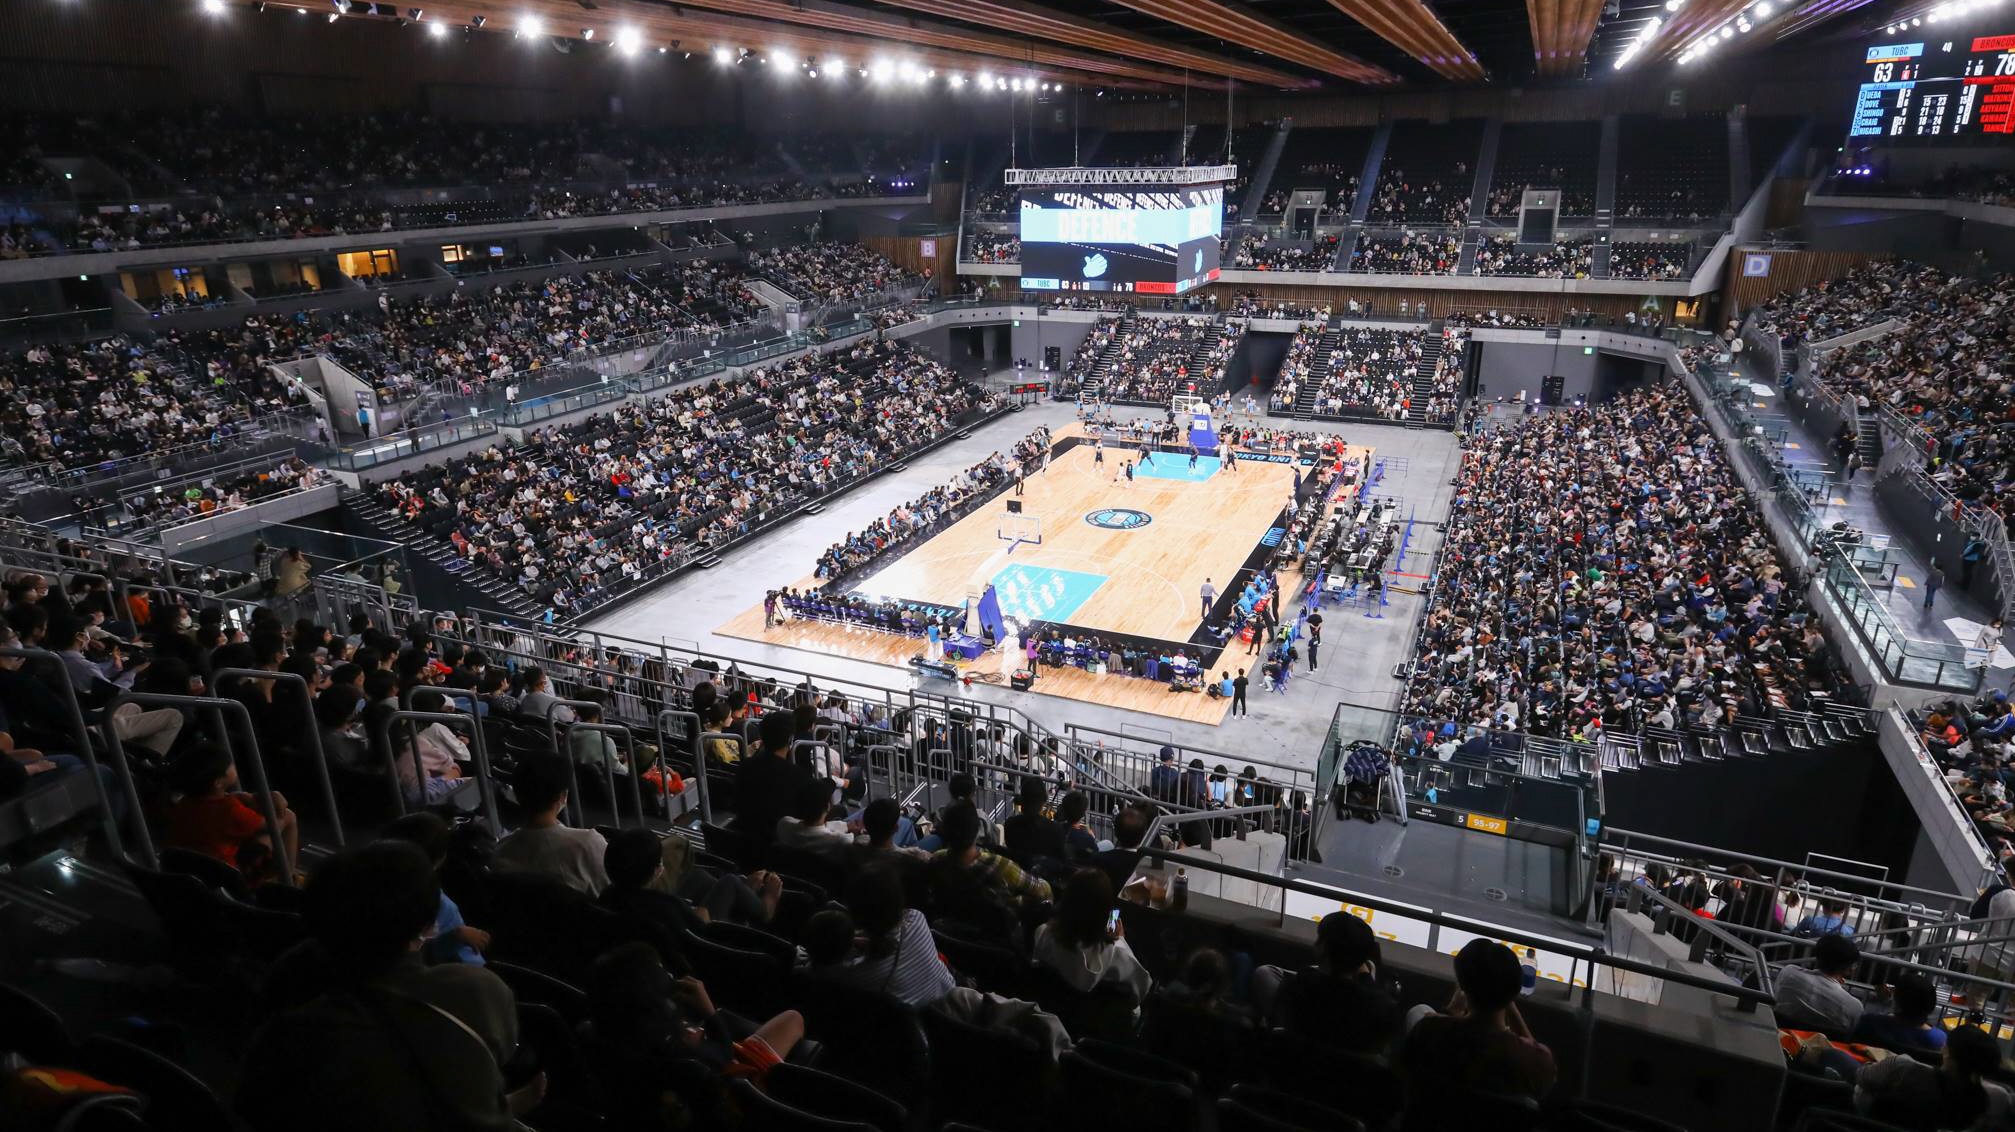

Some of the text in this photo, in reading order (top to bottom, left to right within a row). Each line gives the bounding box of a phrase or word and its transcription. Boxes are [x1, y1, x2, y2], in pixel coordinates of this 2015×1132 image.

[1994, 53, 2015, 76] 78
[1873, 62, 1894, 83] 63
[1670, 90, 1681, 106] E
[1866, 90, 1881, 99] UEDA
[1905, 89, 1911, 98] 3
[1865, 99, 1880, 108] DOVE
[1923, 97, 1932, 106] 15
[1936, 96, 1948, 106] 23
[1862, 108, 1884, 117] SHINGO
[1919, 106, 1930, 116] 21
[1861, 117, 1879, 126] CRAIG
[1932, 115, 1943, 126] 24
[1955, 114, 1962, 124] 5
[1859, 126, 1882, 135] HIGASHI
[1897, 126, 1903, 135] 5
[1931, 125, 1941, 135] 13
[1953, 124, 1960, 134] 5
[924, 242, 933, 255] B
[1748, 257, 1767, 274] D
[989, 275, 1000, 287] A
[1642, 295, 1660, 310] A
[1457, 815, 1500, 830] 5 95-97
